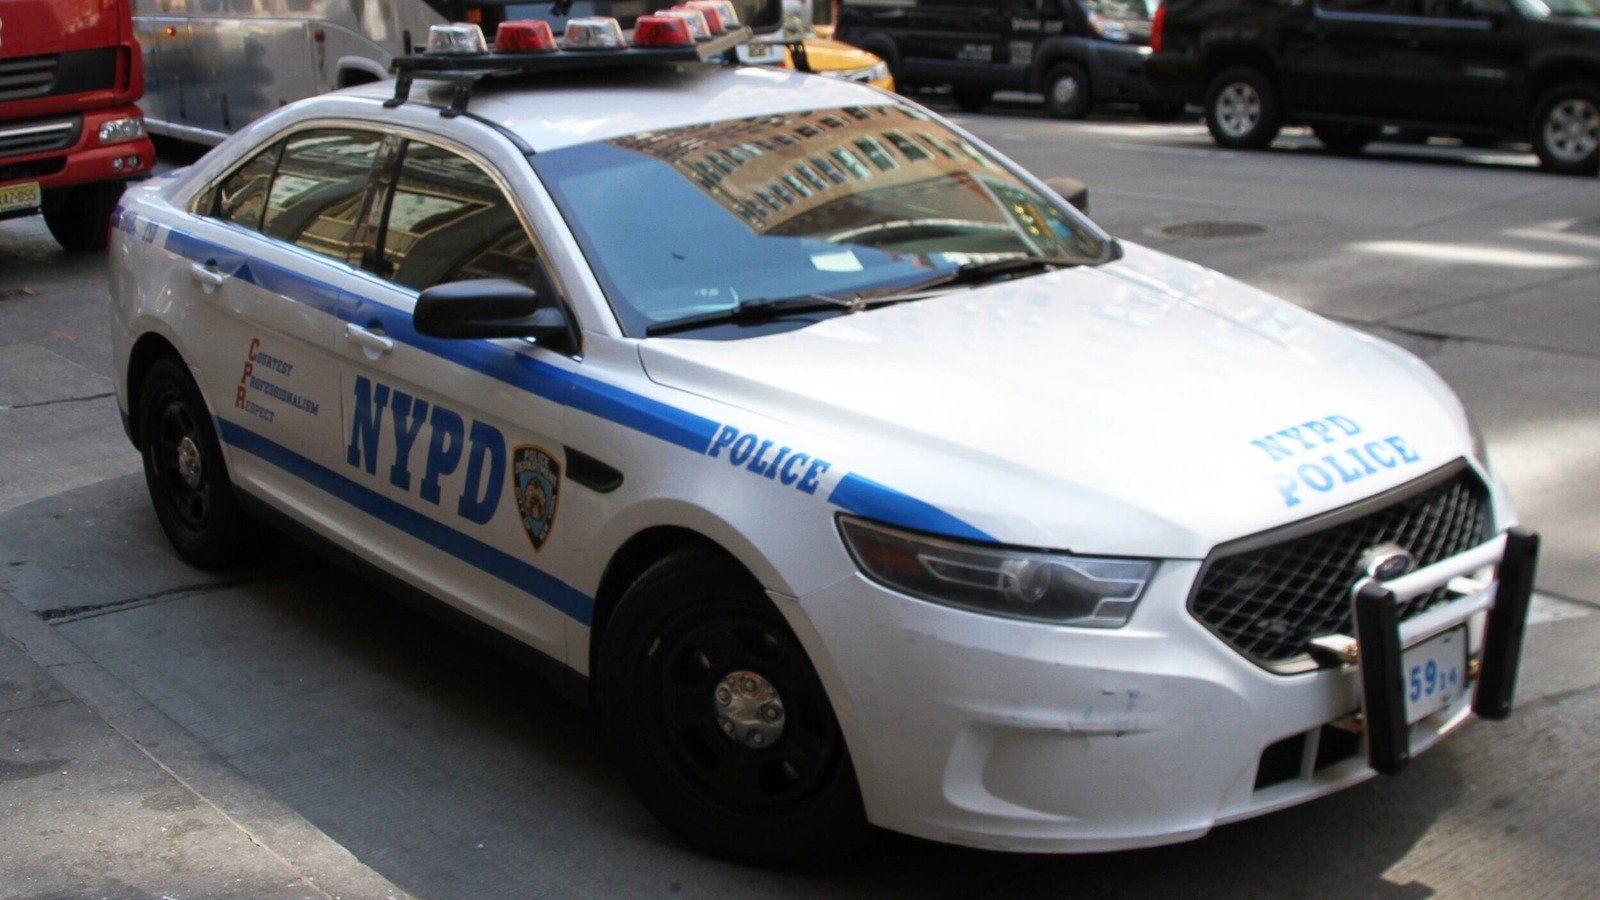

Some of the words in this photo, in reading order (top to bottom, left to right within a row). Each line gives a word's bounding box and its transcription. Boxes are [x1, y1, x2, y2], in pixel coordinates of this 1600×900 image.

[249, 337, 293, 376] COURTESY
[234, 385, 275, 422] RESPECT
[241, 361, 320, 416] PROFESSIONALISM
[347, 374, 507, 526] NYPD
[708, 425, 831, 495] POLICE
[1250, 415, 1361, 461] NYPD
[1270, 436, 1421, 507] POLICE
